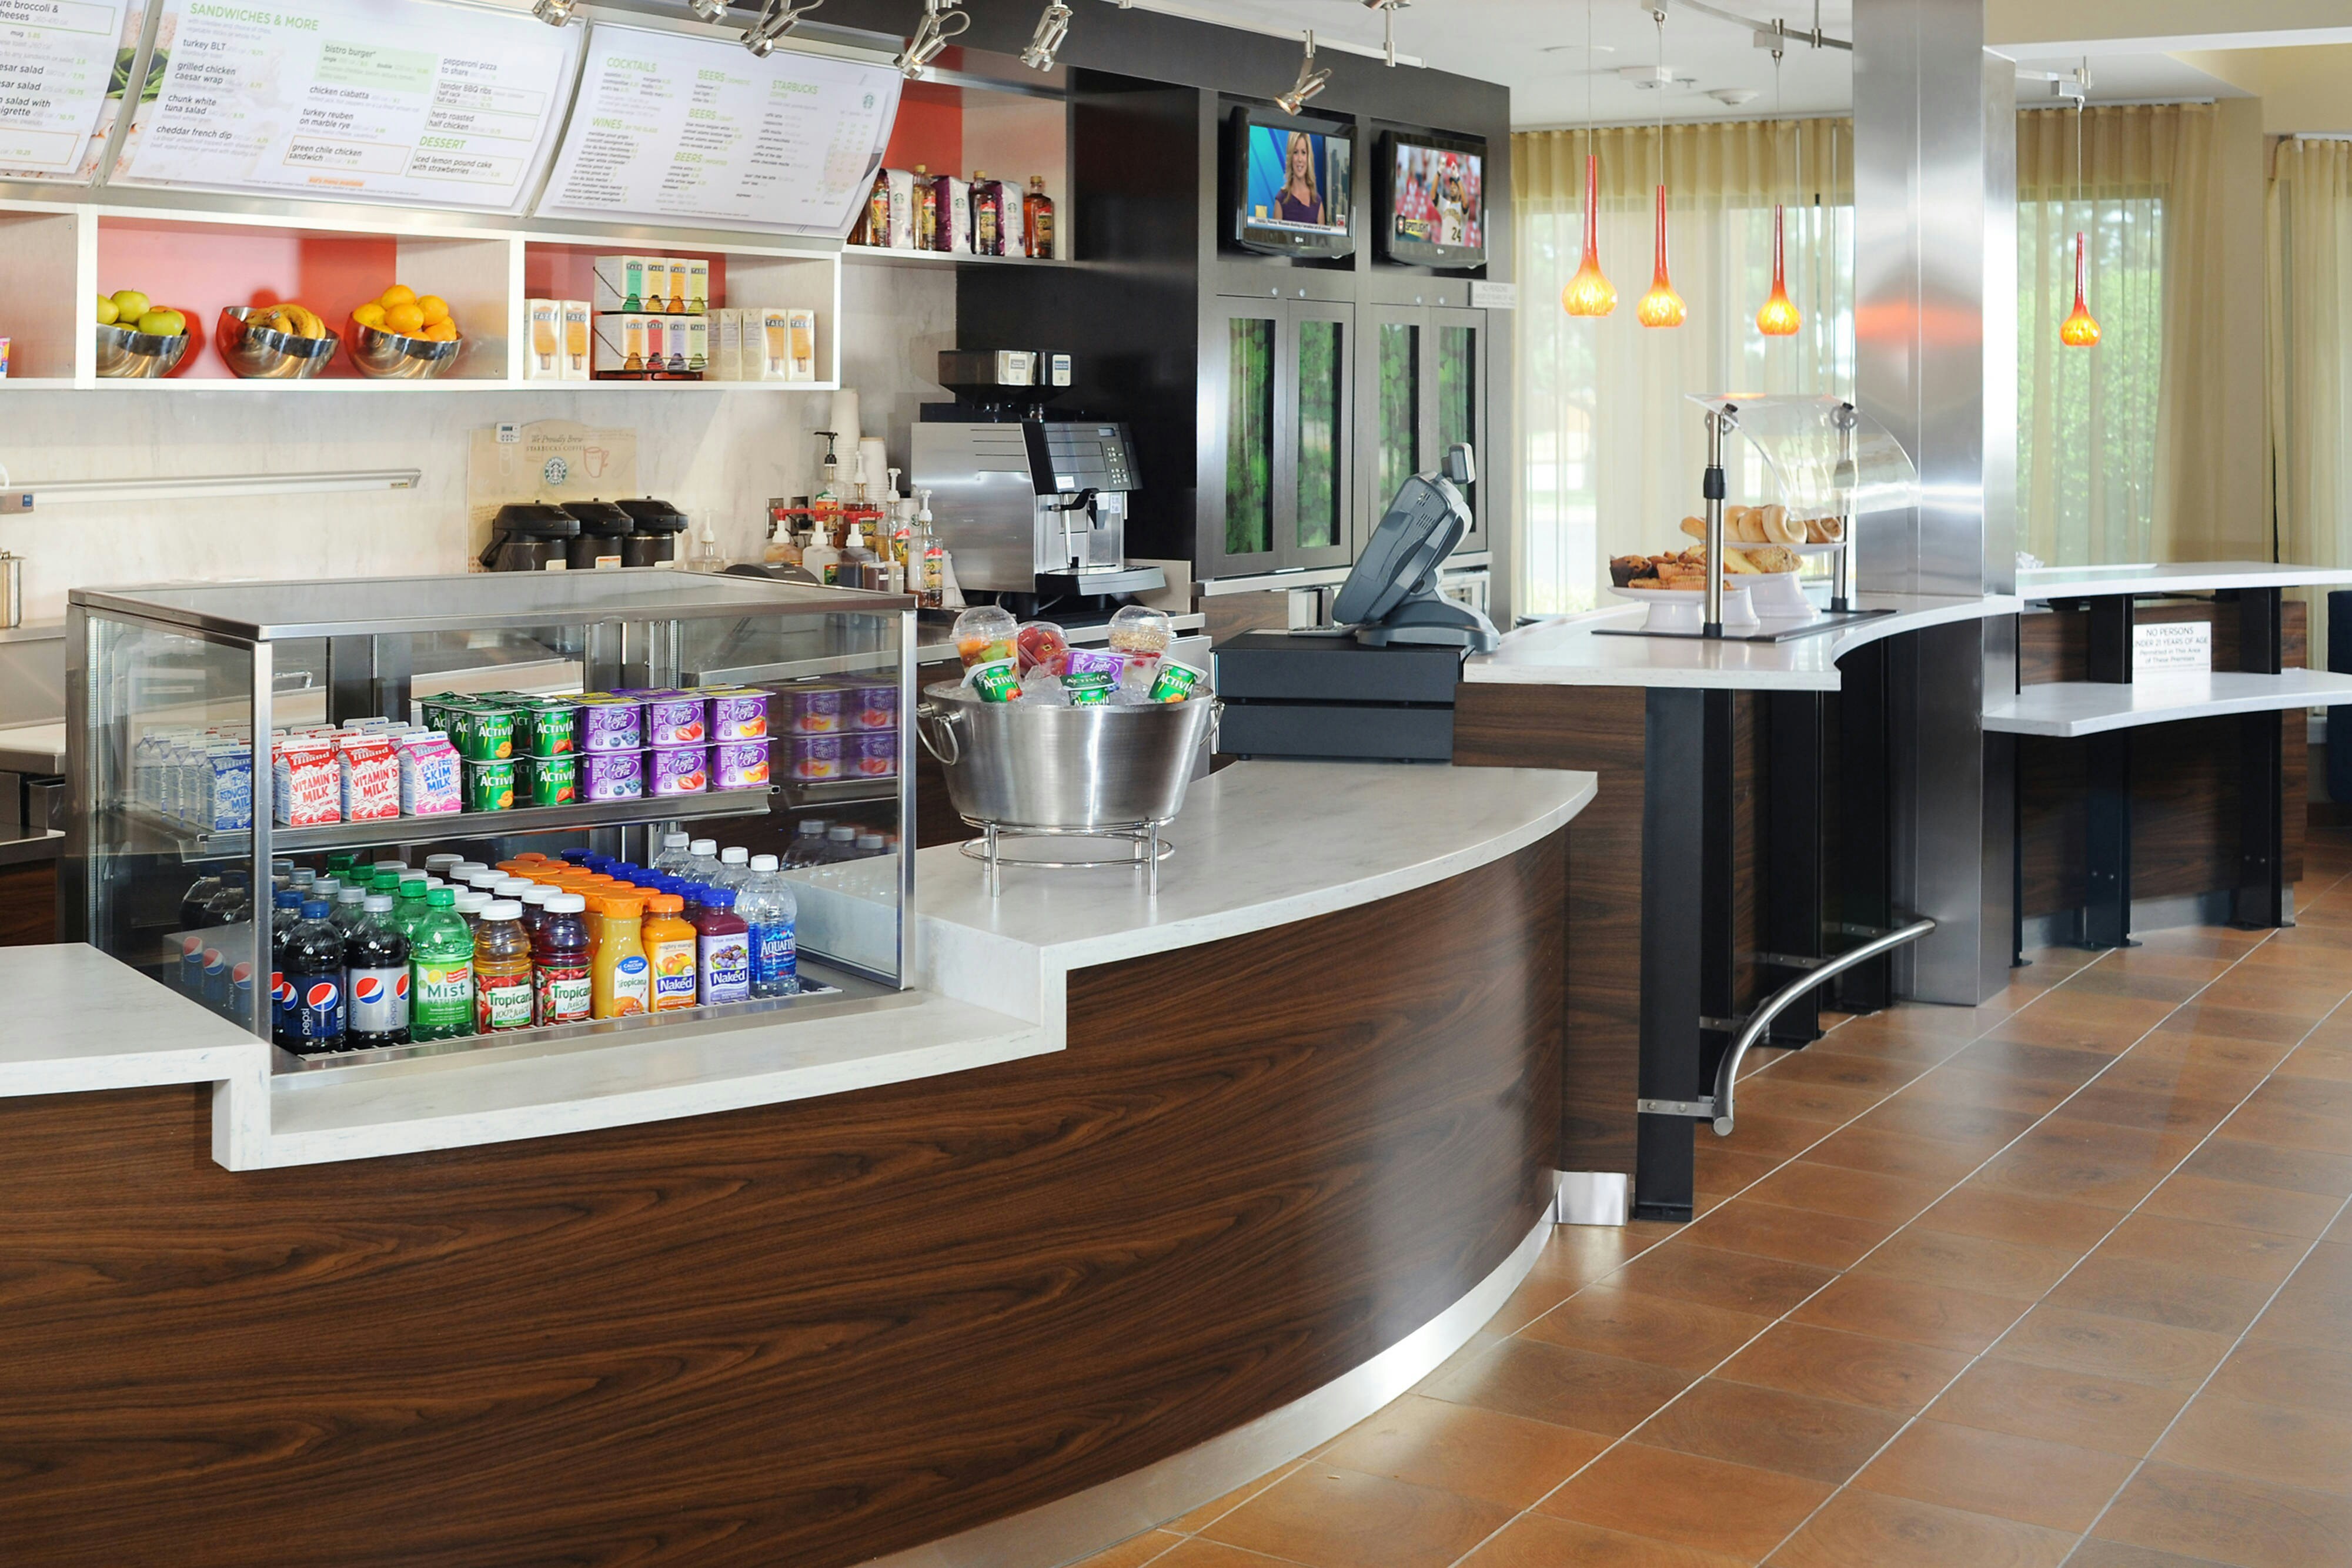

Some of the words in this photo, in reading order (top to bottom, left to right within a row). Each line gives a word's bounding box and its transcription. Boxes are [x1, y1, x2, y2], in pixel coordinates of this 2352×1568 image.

[14, 1, 51, 12] broccoli
[52, 5, 59, 13] &
[190, 3, 270, 25] SANDWICHES
[274, 15, 281, 25] &
[285, 16, 319, 31] MORE
[183, 39, 209, 51] turkey
[211, 42, 226, 51] BLT
[325, 44, 346, 55] bistro
[19, 65, 44, 74] salad
[177, 62, 203, 72] grilled
[206, 65, 236, 75] chicken
[443, 58, 479, 69] pepperoni
[480, 62, 497, 71] pizza
[606, 57, 657, 73] COCKTAILS
[175, 73, 201, 82] caesar
[203, 76, 223, 85] wrap
[697, 69, 726, 82] BEERS
[16, 81, 41, 91] salad
[309, 85, 338, 96] chicken
[340, 88, 369, 99] ciabatta
[440, 82, 462, 92] tender
[463, 85, 479, 93] BBQ
[771, 79, 818, 95] STARBUCKS
[5, 97, 30, 105] salad
[32, 98, 51, 107] with
[168, 94, 192, 103] chunk
[195, 96, 216, 106] white
[165, 104, 183, 112] tuna
[185, 106, 206, 115] salad
[302, 108, 326, 119] turkey
[328, 111, 354, 119] reuben
[689, 108, 717, 120] BEERS
[432, 111, 447, 119] herb
[448, 113, 475, 122] roasted
[311, 119, 337, 128] marble
[428, 119, 442, 128] half
[443, 122, 469, 131] chicken
[592, 117, 623, 129] WINES
[156, 125, 190, 135] cheddar
[191, 128, 217, 138] french
[219, 130, 232, 139] dip
[419, 136, 466, 149] DESSERT
[292, 144, 313, 153] green
[315, 145, 333, 153] chile
[335, 148, 362, 156] chicken
[289, 153, 323, 162] sandwich
[415, 155, 429, 163] iced
[431, 156, 452, 165] lemon
[453, 159, 476, 168] pound
[673, 152, 703, 163] BEERS
[427, 165, 469, 175] strawberries
[1451, 227, 1461, 242] 24
[2160, 627, 2193, 636] PERSONS
[1090, 662, 1111, 670] Light
[1158, 673, 1194, 694] ACTIVIA
[672, 708, 693, 721] Light
[736, 704, 755, 717] Light
[746, 711, 754, 719] Fit
[607, 712, 629, 725] Light
[618, 720, 627, 728] Fit
[537, 720, 574, 734] ACTIVIA
[739, 748, 759, 761] Light
[749, 755, 758, 764] Fit
[437, 758, 453, 768] FREE
[611, 761, 632, 774] Light
[675, 757, 696, 770] Light
[685, 764, 694, 773] Fit
[353, 769, 389, 787] VITAMIN
[391, 768, 398, 777] D
[424, 767, 451, 782] SKIM
[621, 768, 630, 777] Fit
[292, 773, 329, 793] VITAMIN
[332, 773, 340, 783] D
[426, 777, 451, 793] MILK
[302, 785, 329, 803] MILK
[363, 781, 388, 798] MILK
[617, 978, 647, 988] Tropicana
[713, 971, 746, 984] Naked
[427, 983, 465, 998] Mist
[659, 978, 693, 992] Naked
[300, 1008, 312, 1035] pepsi
